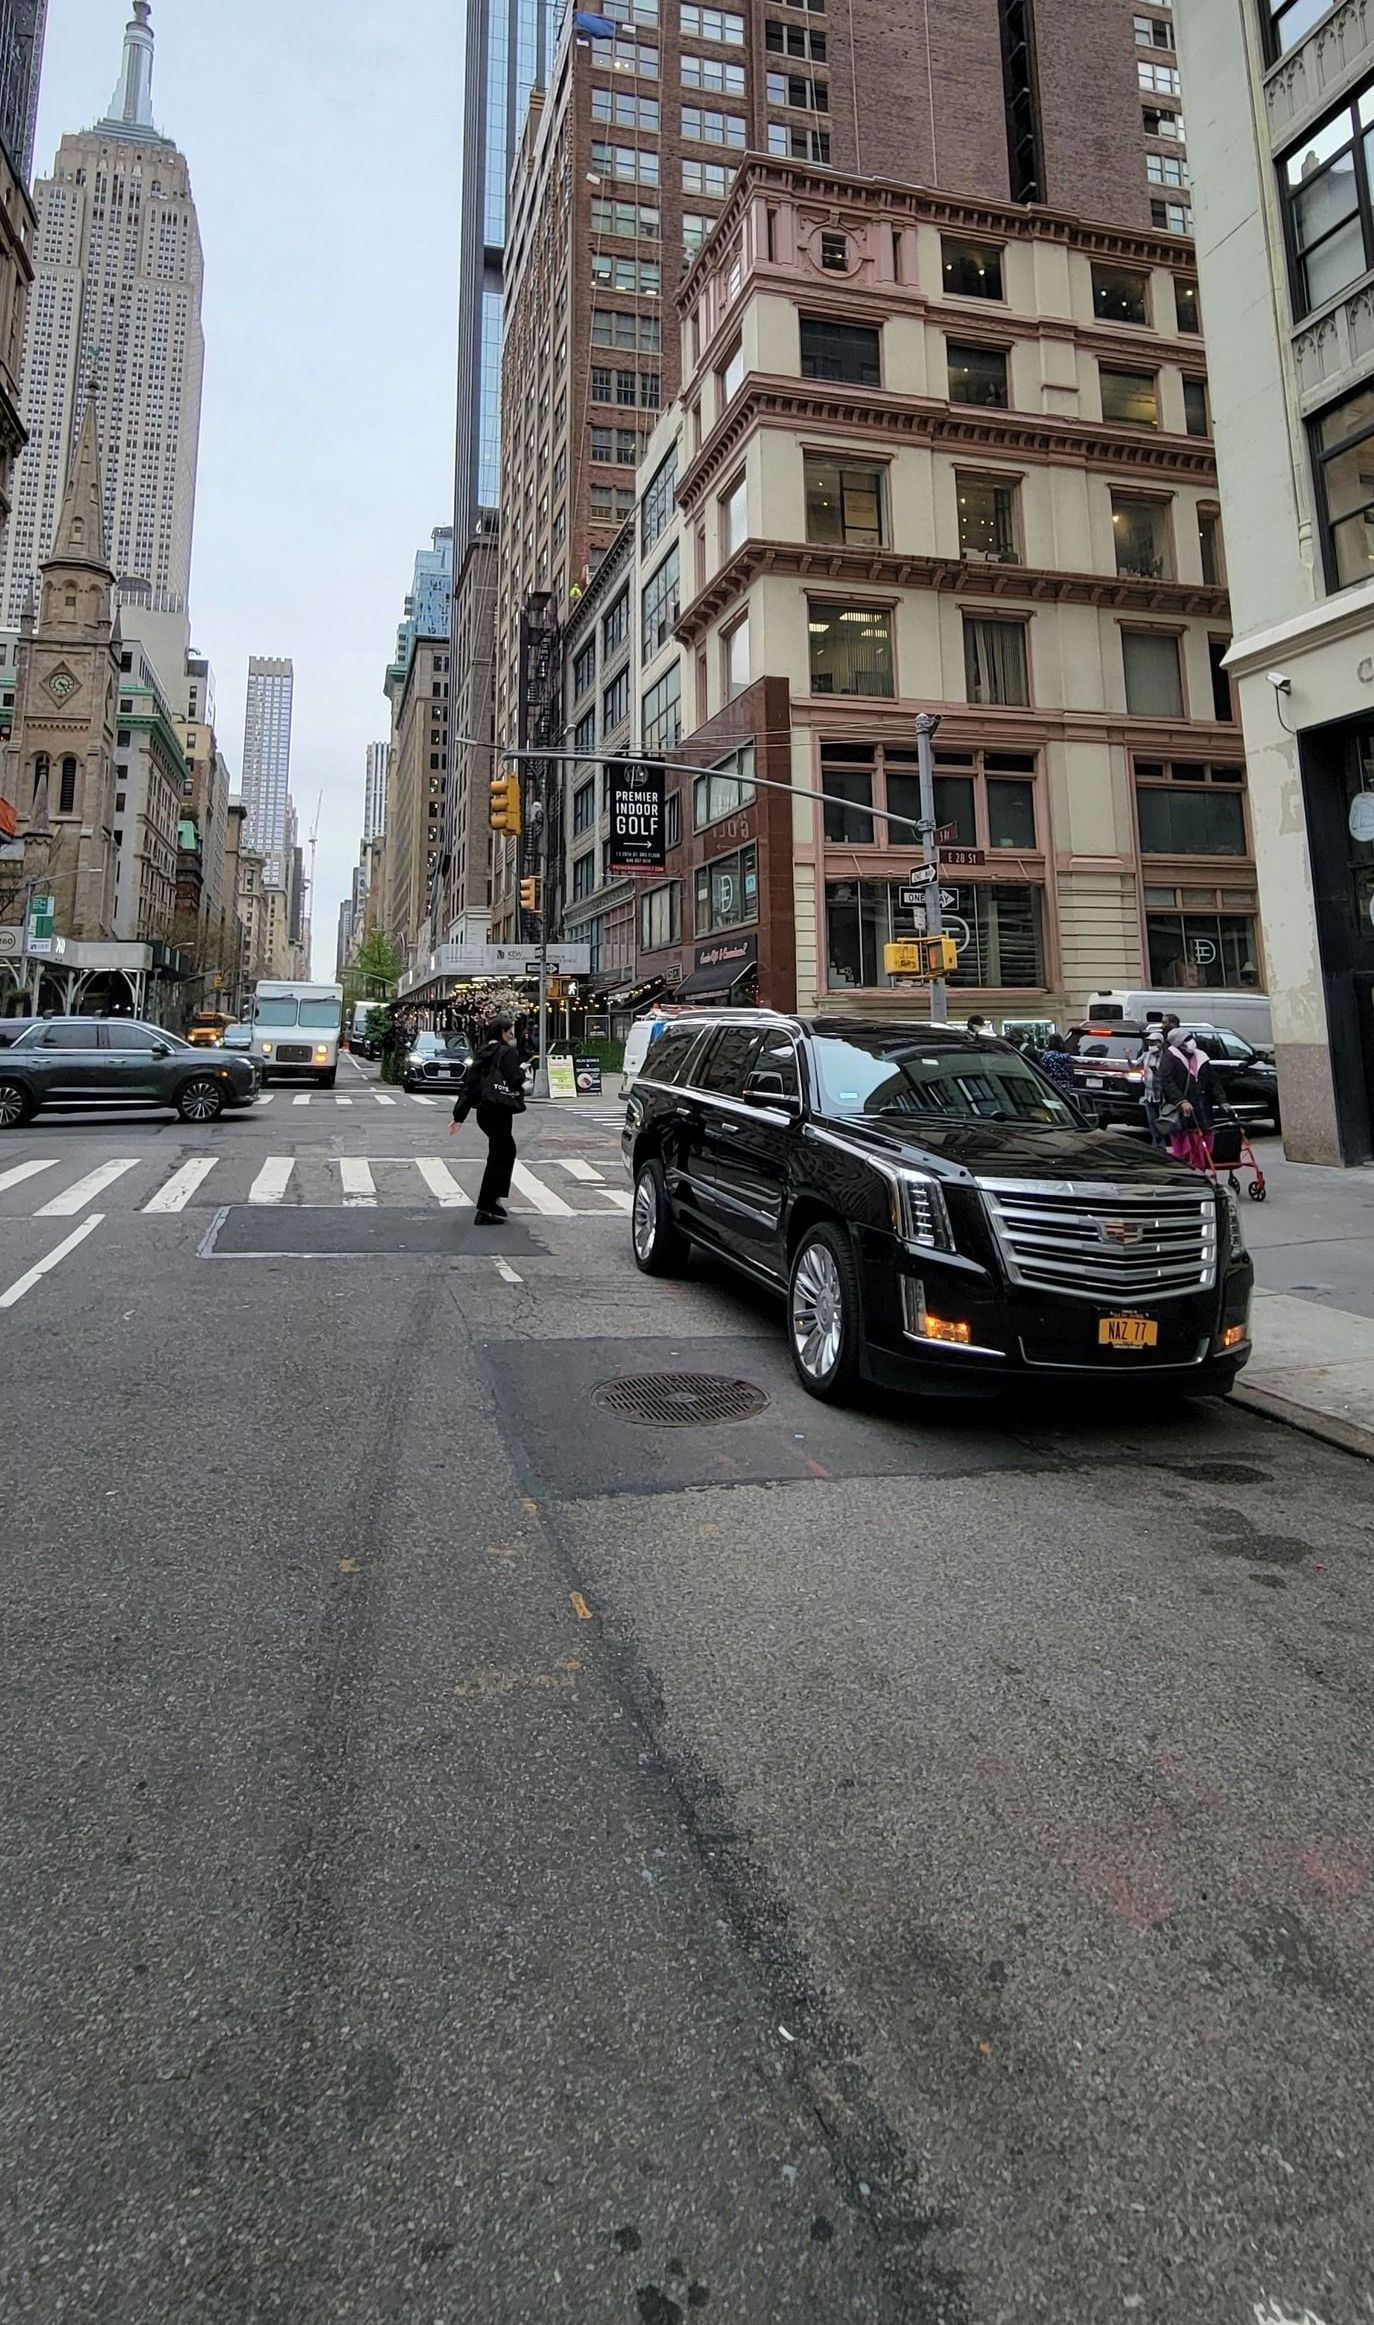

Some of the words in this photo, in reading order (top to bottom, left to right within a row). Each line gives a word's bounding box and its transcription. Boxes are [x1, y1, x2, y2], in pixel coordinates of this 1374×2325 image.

[616, 791, 658, 802] PREMIER
[616, 803, 658, 816] INDOOR
[616, 816, 659, 836] GOLF
[948, 852, 953, 863] E
[955, 852, 965, 863] 28
[967, 852, 977, 864] St
[913, 872, 922, 881] ONE
[925, 869, 934, 878] WAY
[909, 894, 926, 903] ONE
[1109, 1321, 1128, 1340] NAZ
[1134, 1322, 1147, 1341] 77
